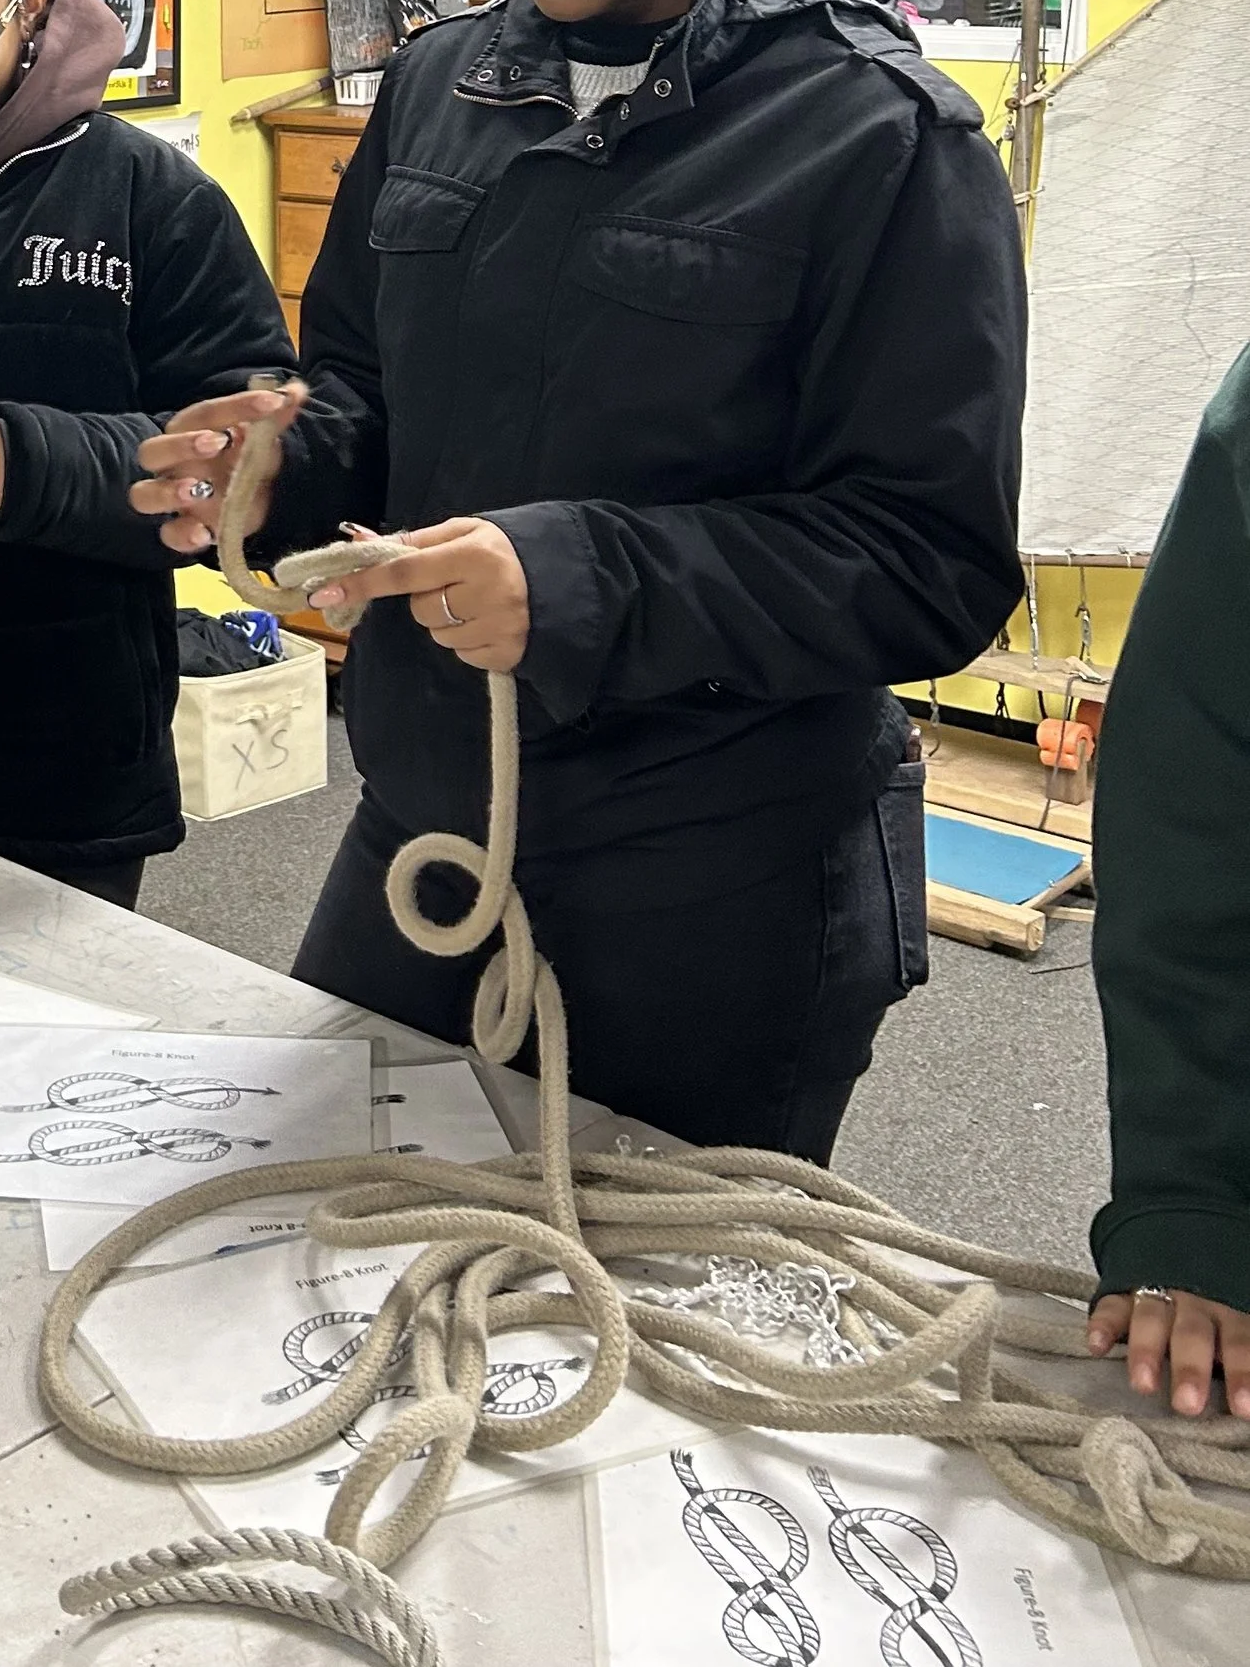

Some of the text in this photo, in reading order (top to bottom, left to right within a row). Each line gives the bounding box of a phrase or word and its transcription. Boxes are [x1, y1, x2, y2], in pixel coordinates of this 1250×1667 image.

[111, 1049, 196, 1061] Figure-8 Knot
[250, 1222, 283, 1233] Knot
[295, 1262, 390, 1290] Figure-8 Knot
[1013, 1567, 1054, 1652] Figure-8 Knot
